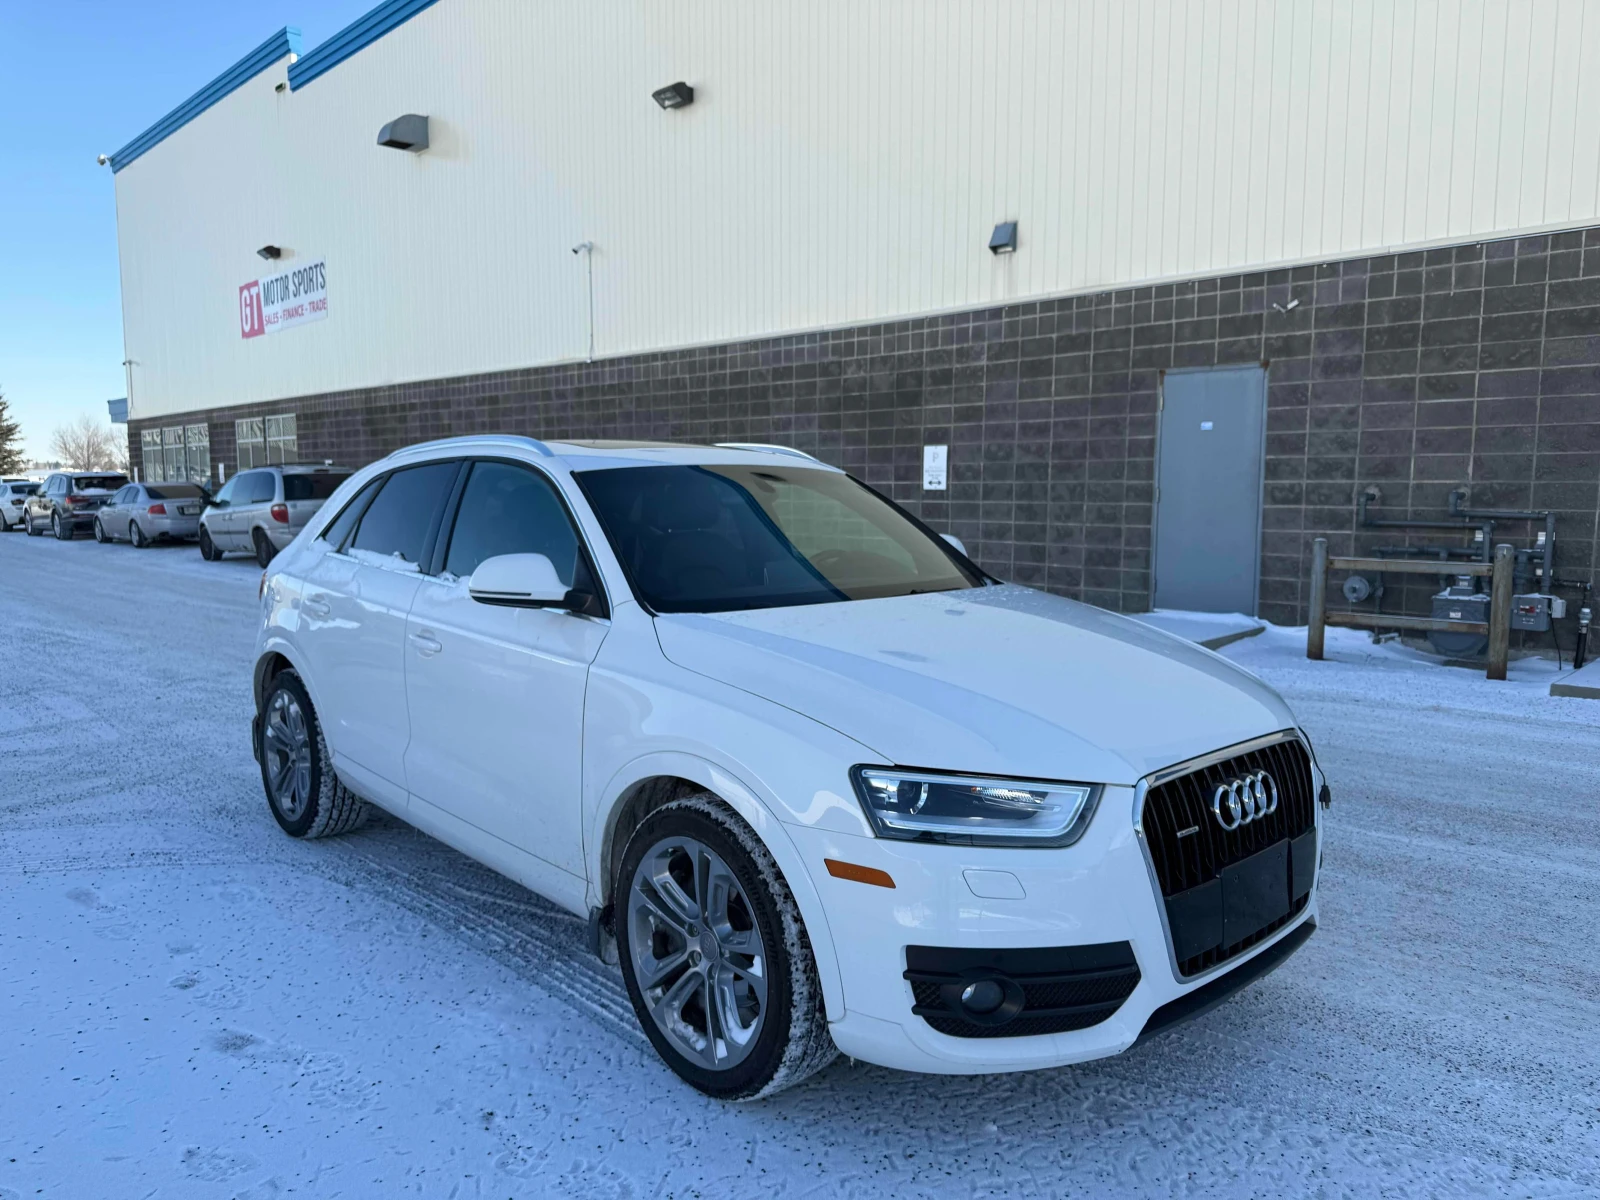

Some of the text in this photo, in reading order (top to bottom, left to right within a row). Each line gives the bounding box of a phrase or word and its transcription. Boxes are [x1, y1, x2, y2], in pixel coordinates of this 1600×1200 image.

[263, 262, 326, 307] MOTOR SPORTS
[241, 286, 259, 333] GT
[265, 298, 327, 326] SALES FINANCE TRADE
